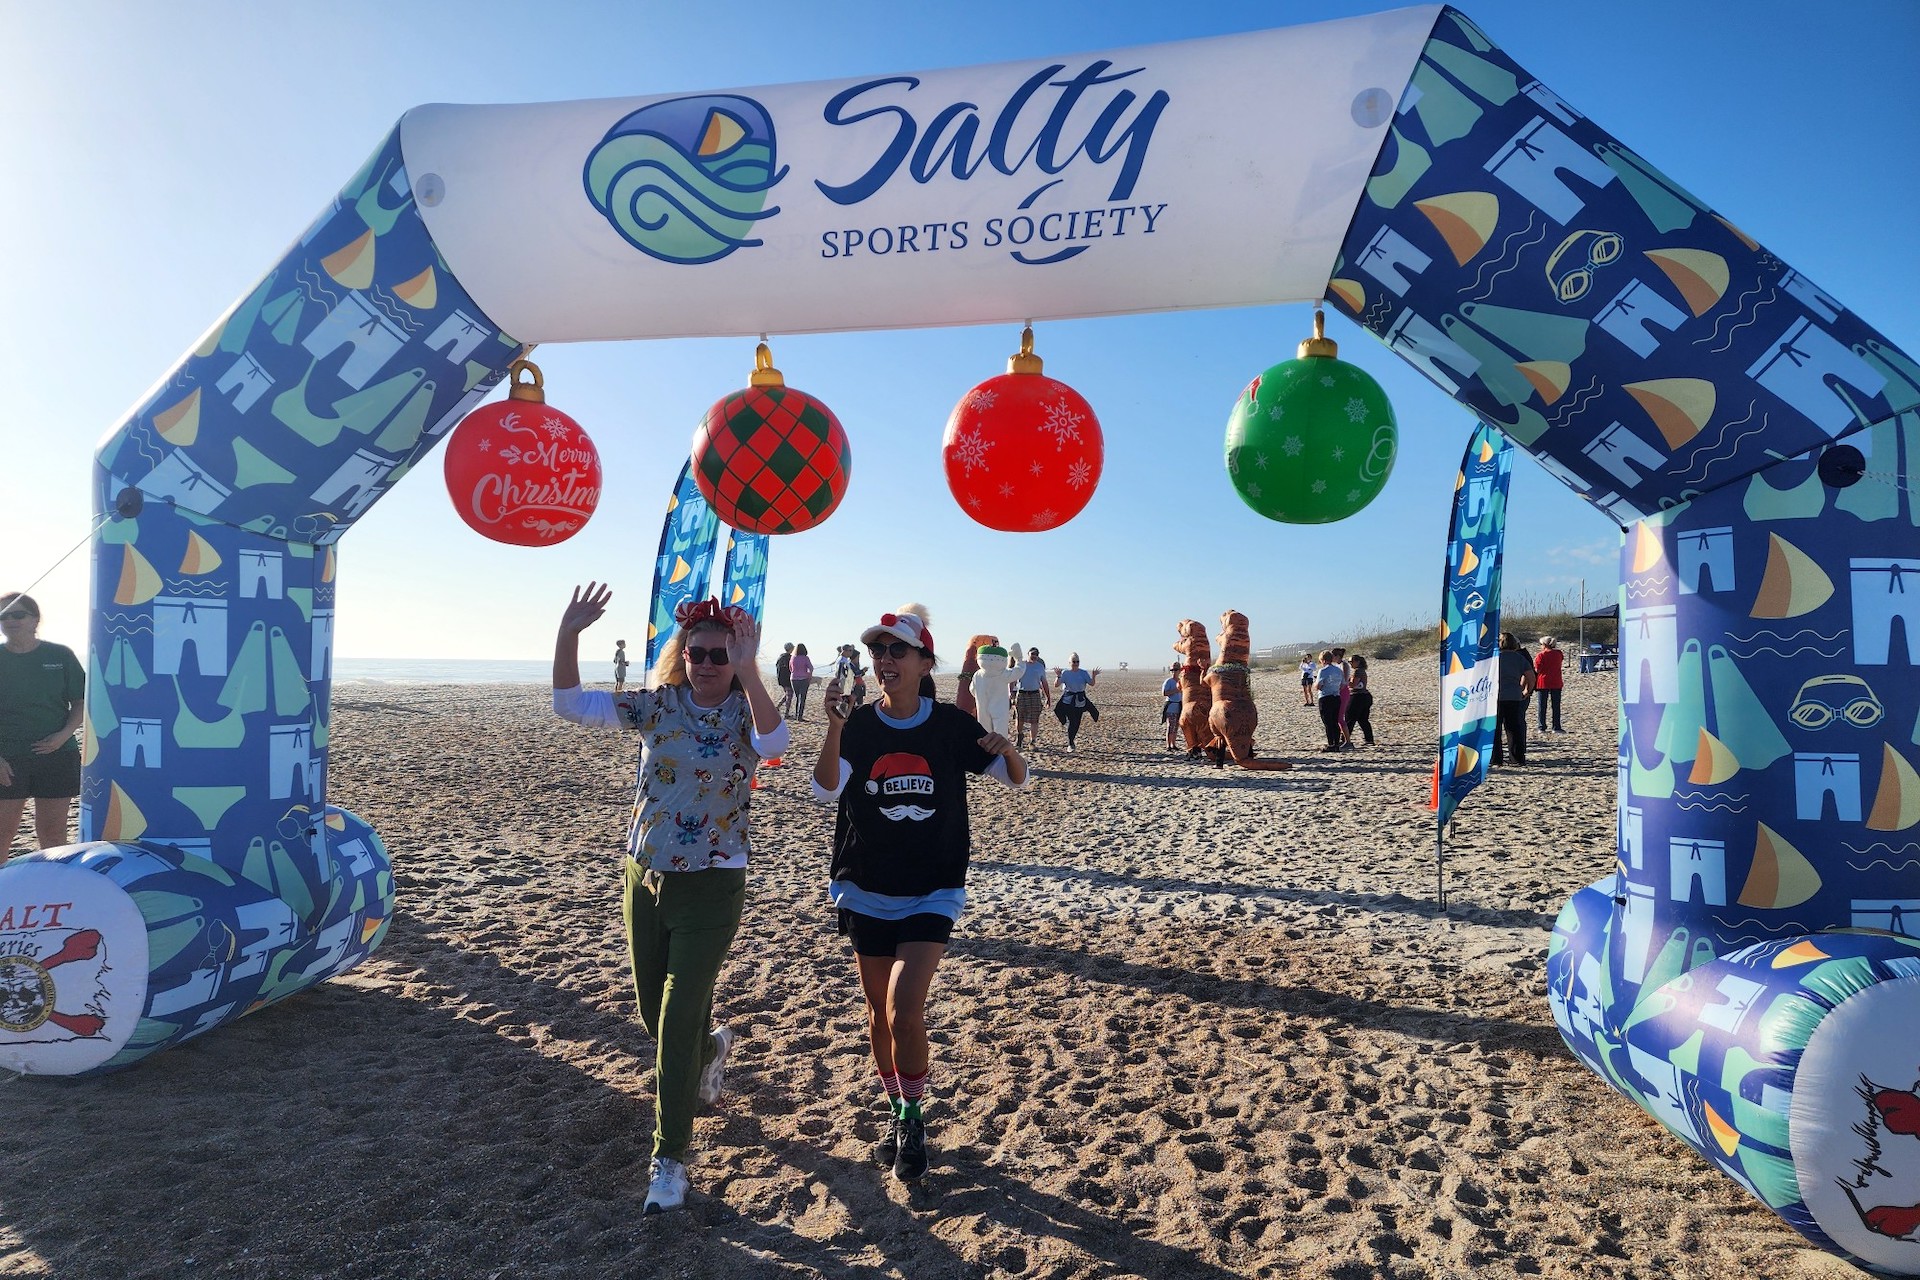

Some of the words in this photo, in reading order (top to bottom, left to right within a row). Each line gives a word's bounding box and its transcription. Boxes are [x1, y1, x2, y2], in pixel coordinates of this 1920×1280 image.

[813, 60, 1170, 205] Salty
[821, 220, 969, 258] SPORTS
[983, 203, 1168, 247] SOCIETY
[522, 441, 593, 472] Merry
[886, 779, 932, 791] BELIEVE
[0, 903, 72, 930] ALT
[0, 934, 42, 957] eries
